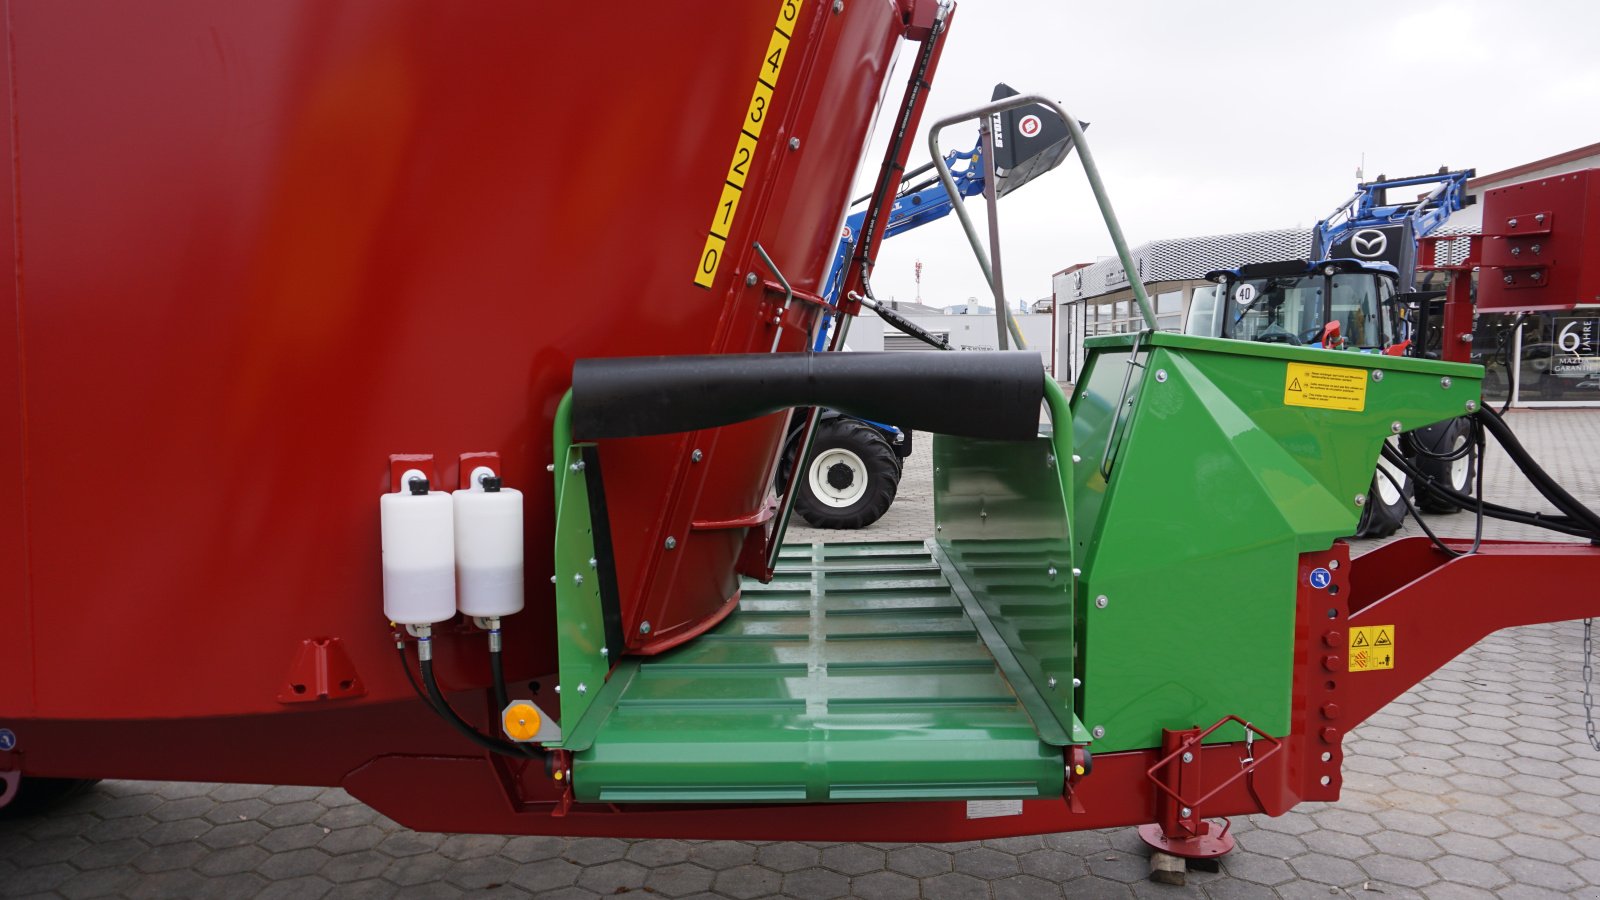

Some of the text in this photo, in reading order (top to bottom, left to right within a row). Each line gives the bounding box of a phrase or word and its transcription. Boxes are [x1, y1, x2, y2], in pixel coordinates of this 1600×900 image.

[784, 0, 799, 21] 5
[767, 48, 782, 73] 4
[751, 97, 765, 123] 3
[733, 147, 750, 176] 2
[724, 200, 733, 225] 1
[703, 248, 717, 274] 0
[1239, 287, 1251, 300] 40
[1558, 321, 1580, 352] 6
[1582, 320, 1592, 351] JAHRE
